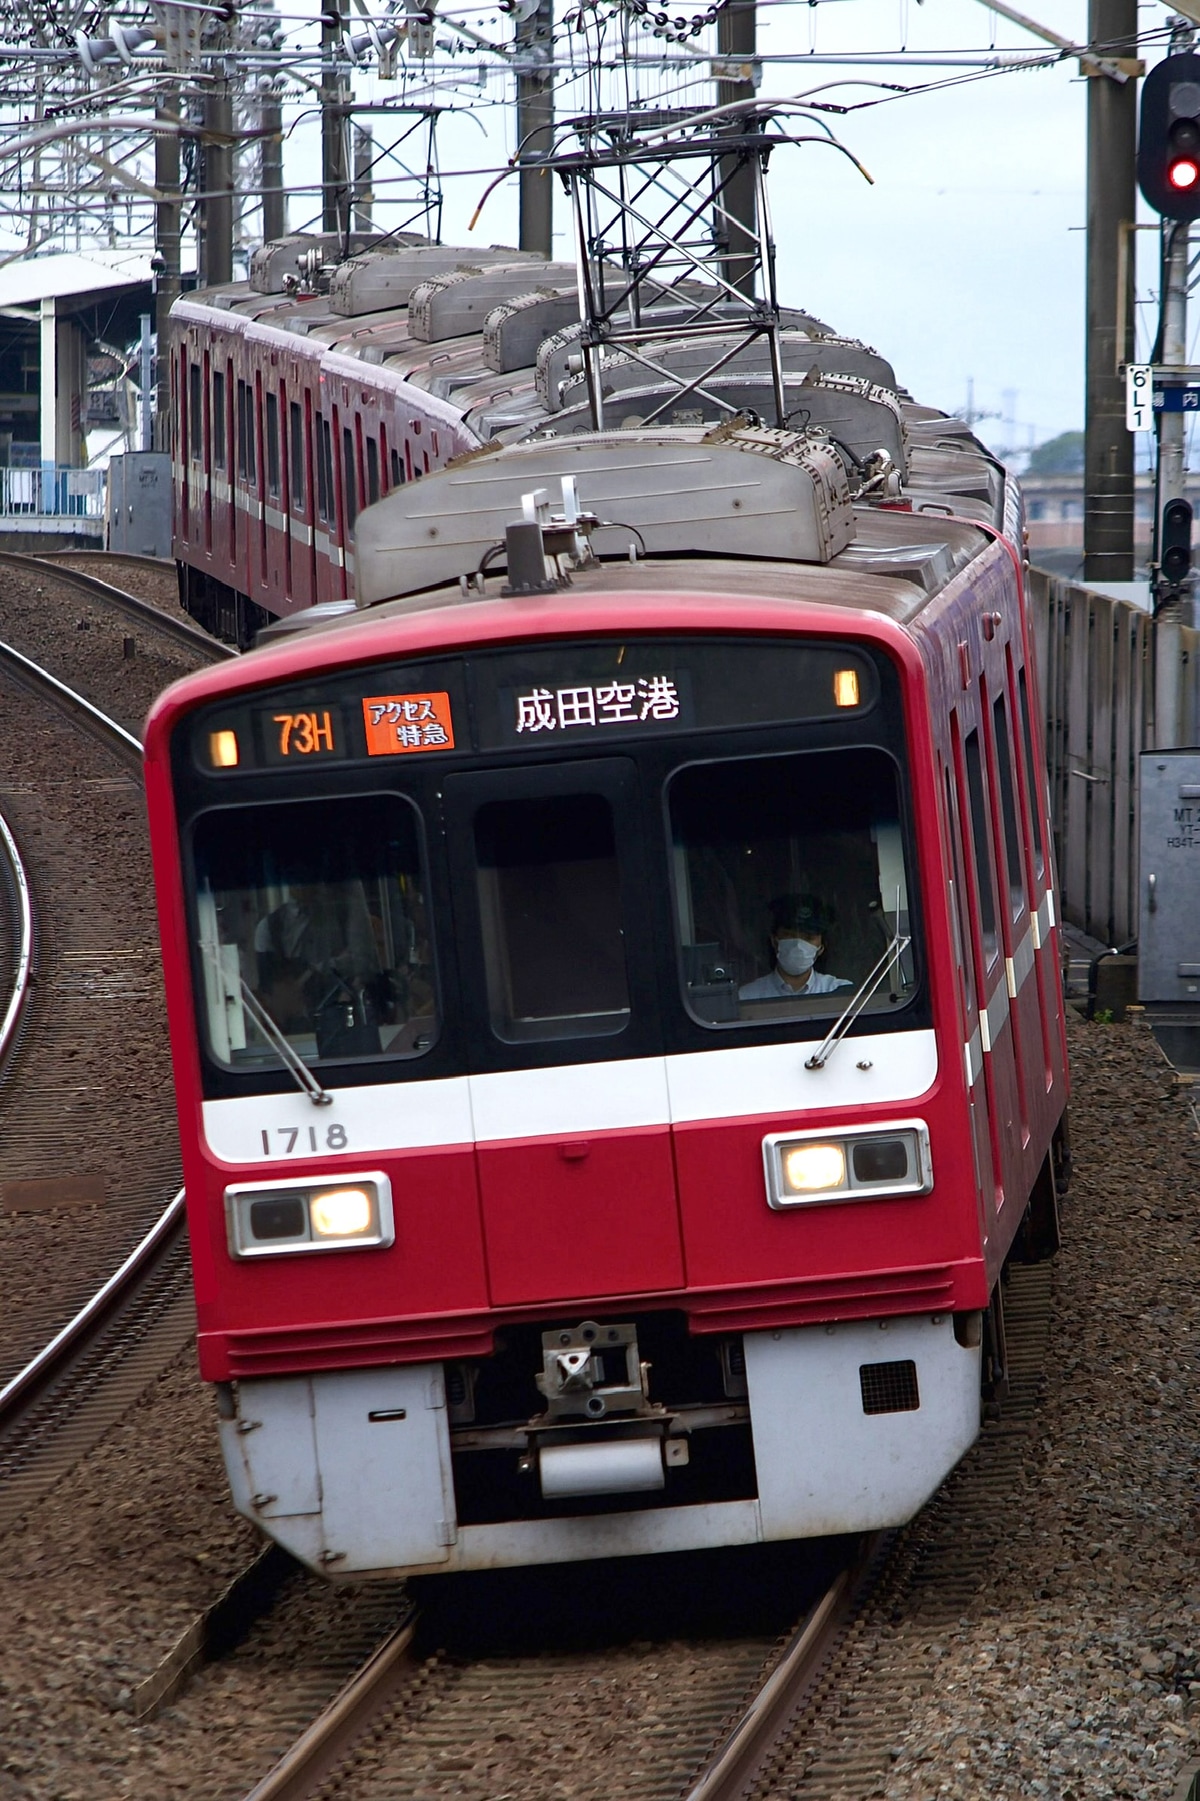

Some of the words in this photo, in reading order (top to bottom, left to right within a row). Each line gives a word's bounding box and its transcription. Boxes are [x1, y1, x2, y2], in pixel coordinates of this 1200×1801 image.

[1133, 371, 1146, 426] 6L1
[369, 700, 436, 725] アクセス
[516, 676, 679, 733] 成田空港
[273, 712, 334, 755] 73H
[397, 724, 449, 747] 特急
[261, 1124, 348, 1155] 1718
